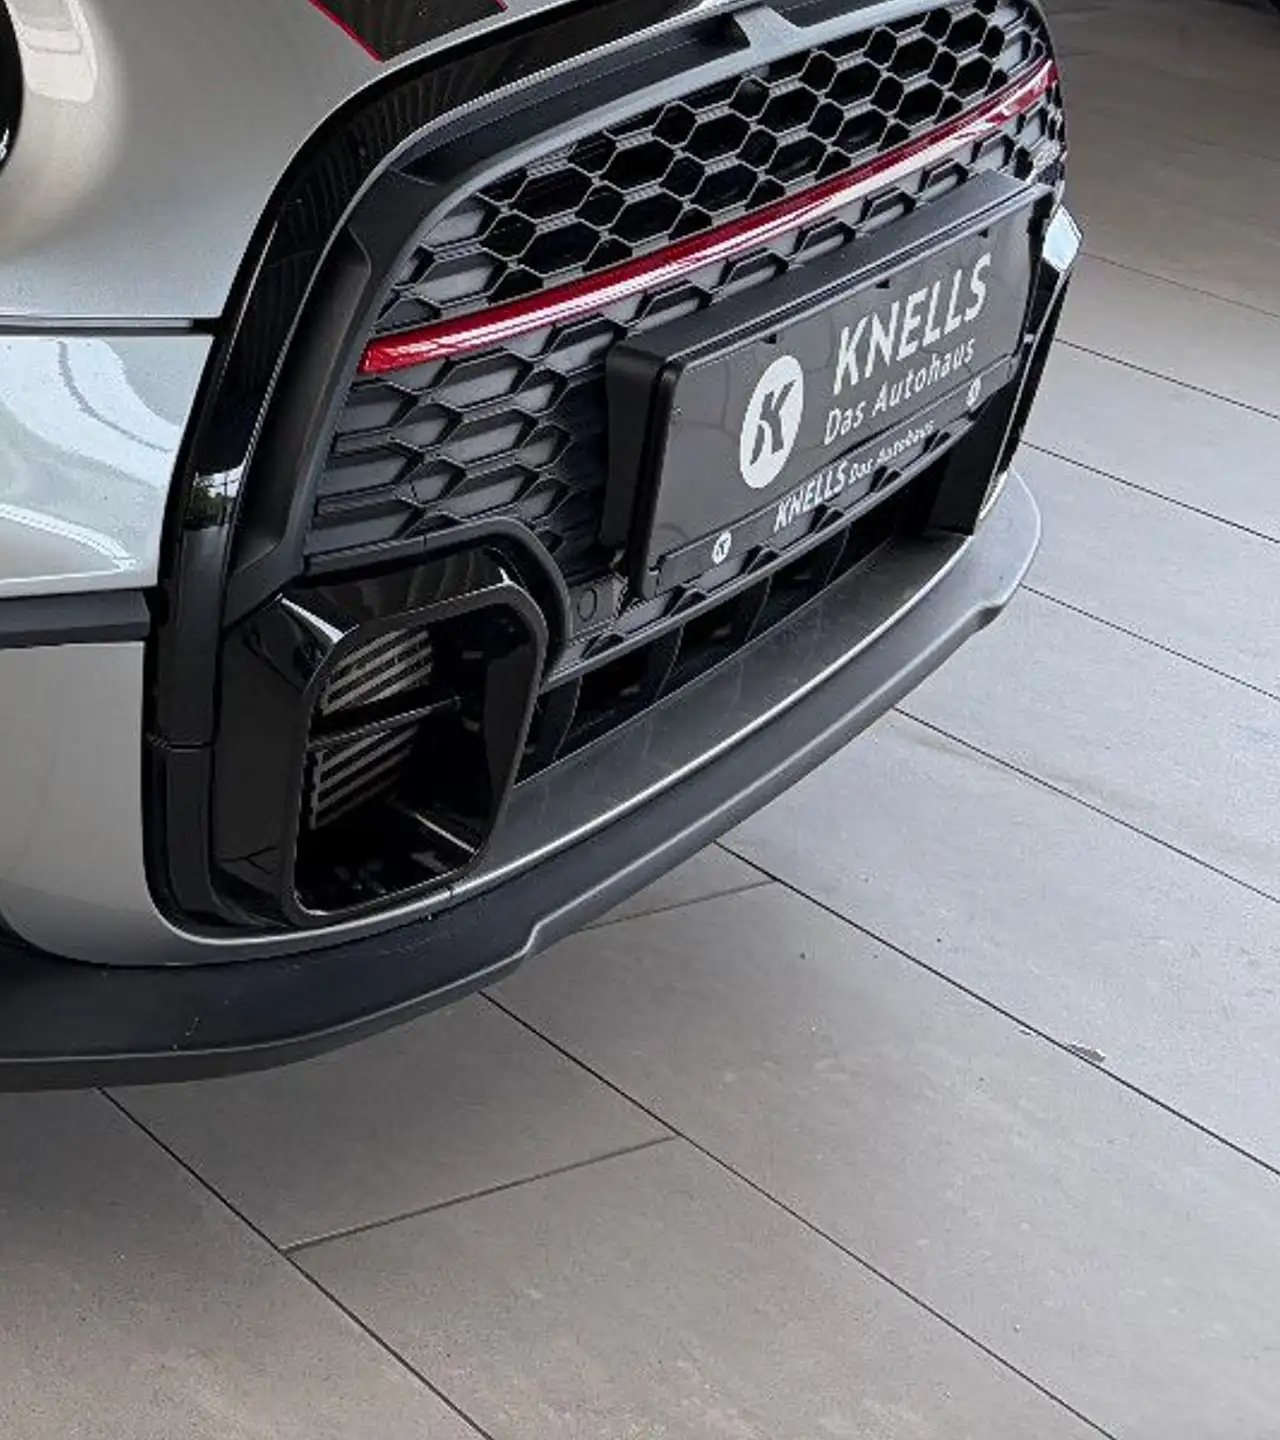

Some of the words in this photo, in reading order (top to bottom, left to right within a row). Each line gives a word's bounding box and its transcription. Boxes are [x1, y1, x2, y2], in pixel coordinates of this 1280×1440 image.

[833, 252, 993, 396] KNELLS
[824, 406, 863, 446] Das
[873, 338, 975, 416] Autohaus
[774, 459, 848, 533] KNELLS
